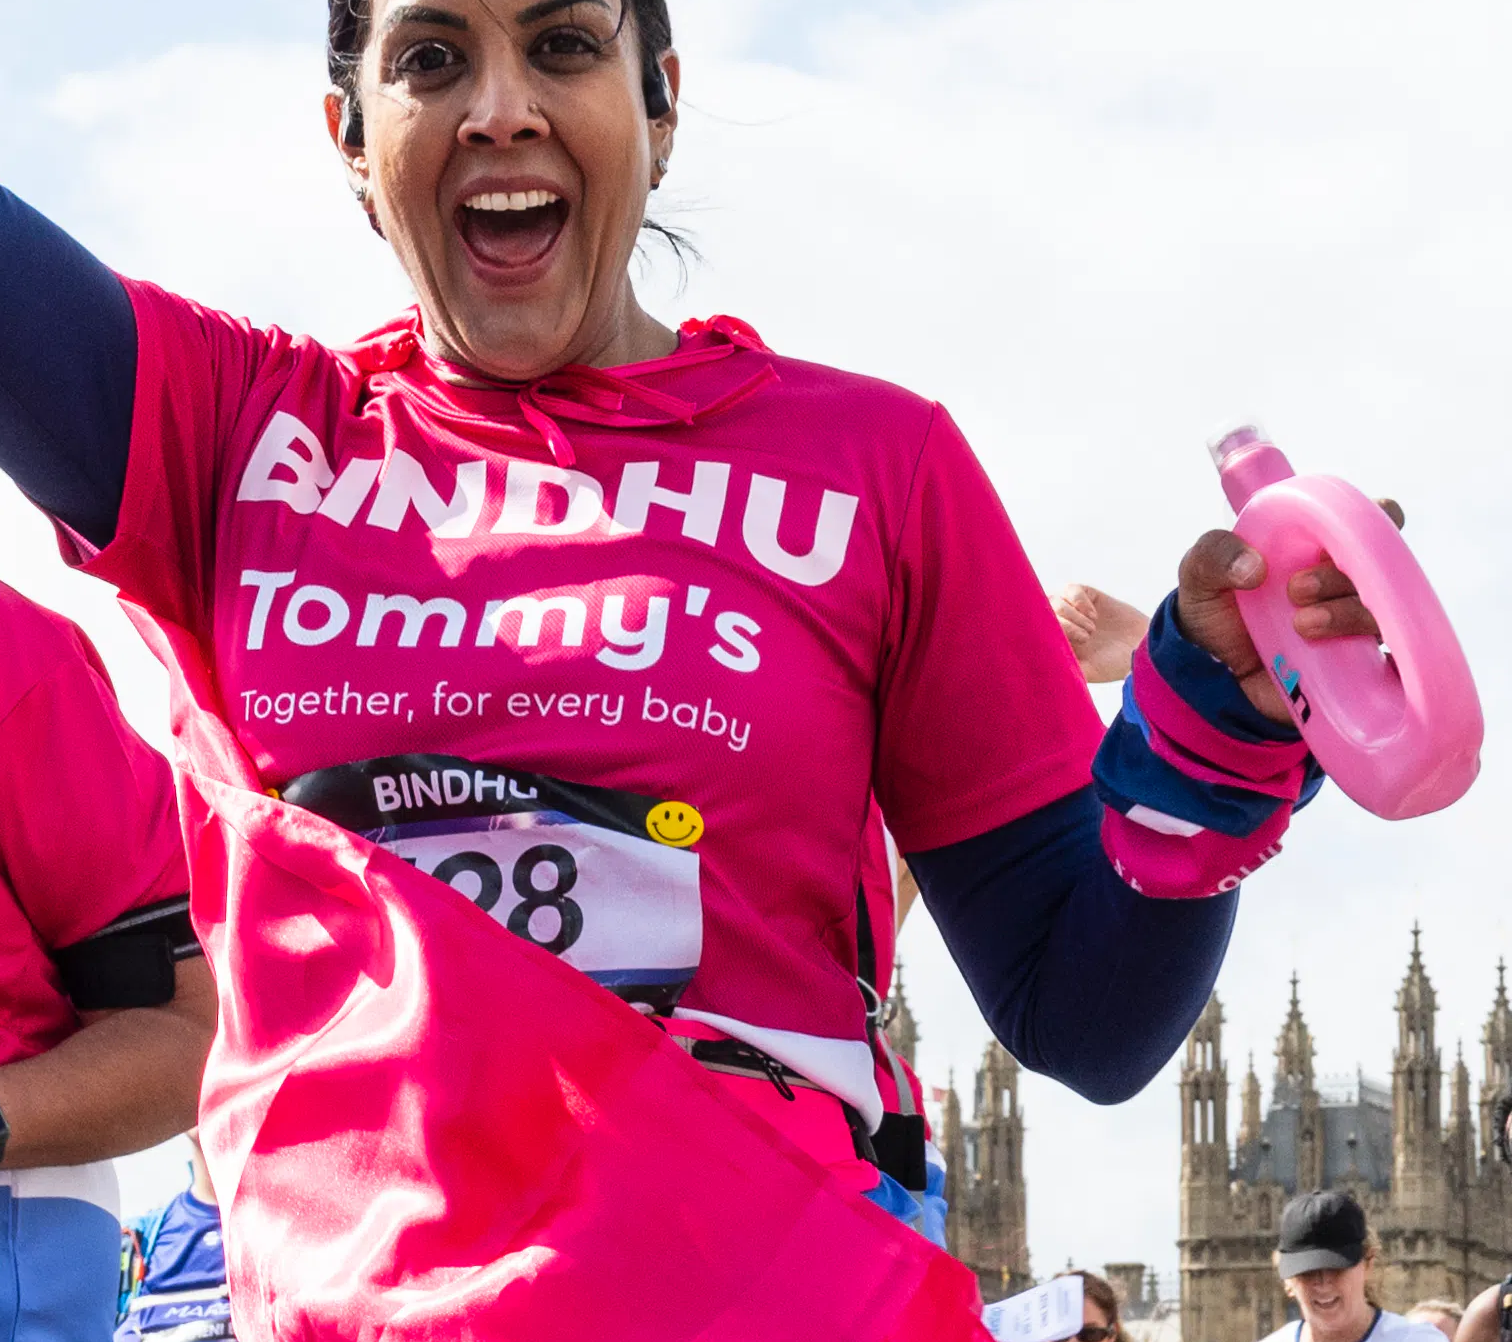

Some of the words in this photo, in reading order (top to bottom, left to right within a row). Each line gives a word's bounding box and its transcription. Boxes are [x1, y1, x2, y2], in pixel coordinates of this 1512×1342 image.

[237, 410, 859, 586] BINDHU
[239, 569, 762, 672] Tommy's
[240, 681, 414, 724] Together,
[432, 680, 491, 717] for
[506, 687, 626, 726] every
[641, 687, 752, 752] baby
[400, 843, 584, 956] 28
